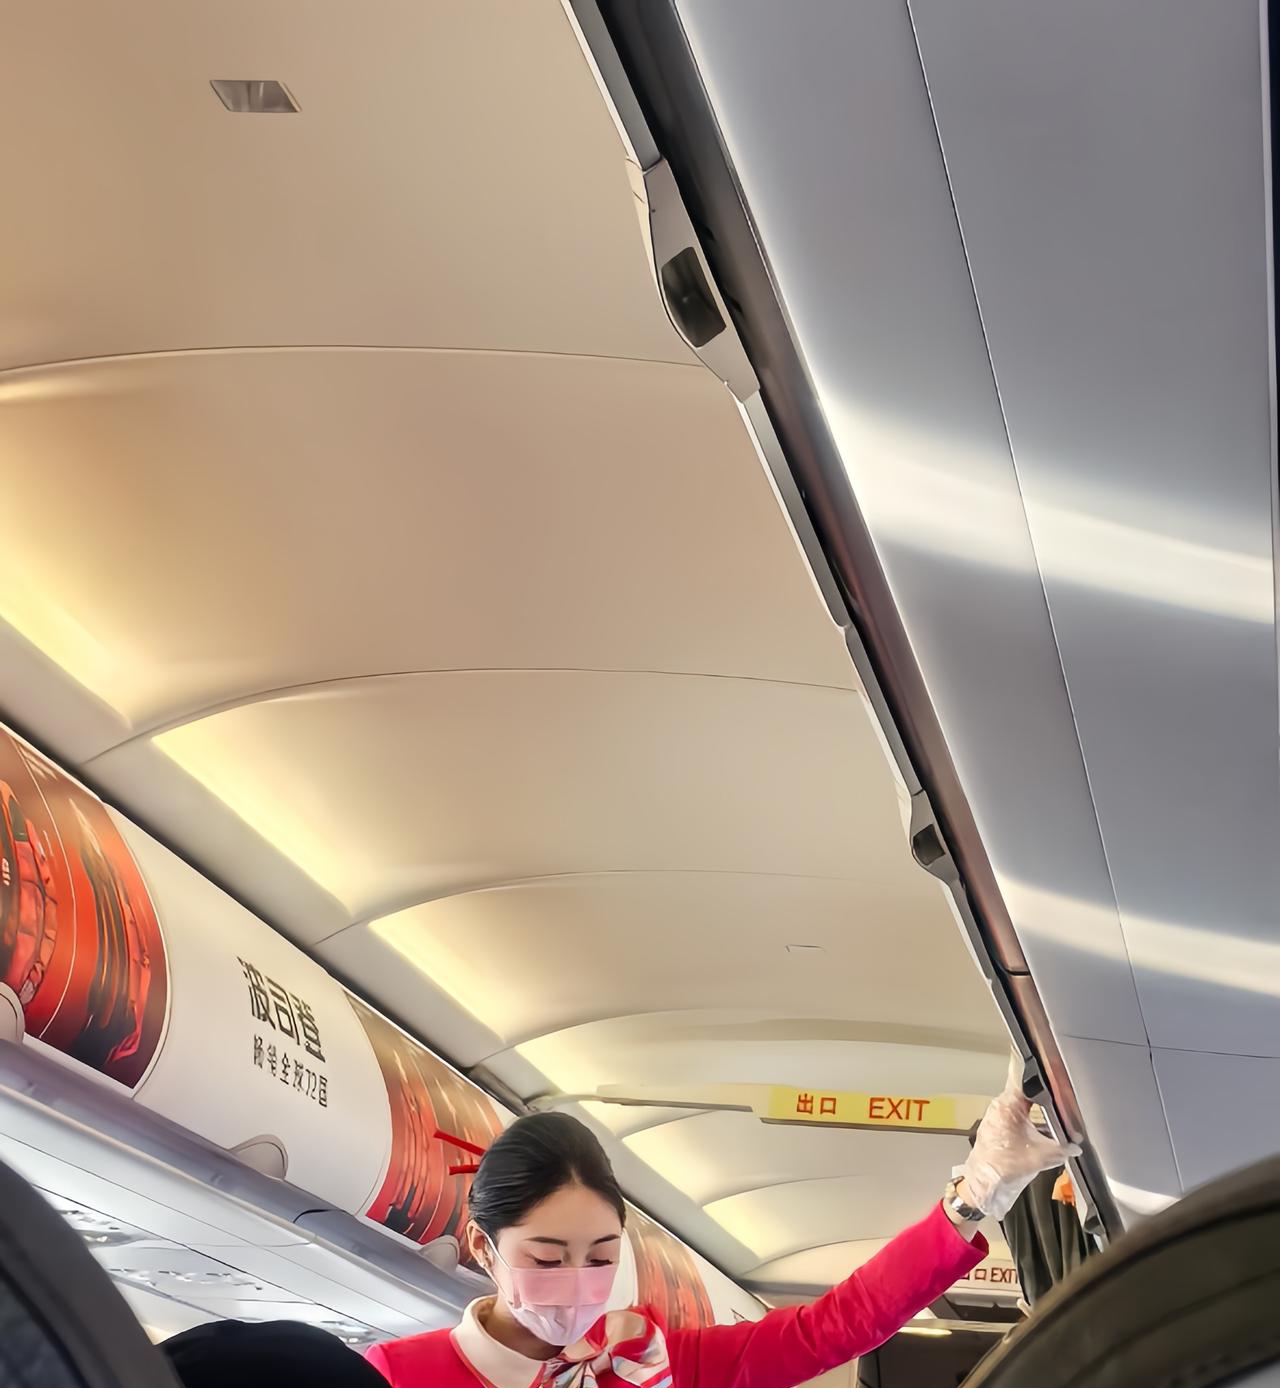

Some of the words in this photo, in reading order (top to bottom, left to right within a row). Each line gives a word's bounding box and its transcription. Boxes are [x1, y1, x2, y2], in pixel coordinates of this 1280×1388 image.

[236, 956, 326, 1063] 波司登
[796, 1093, 837, 1115] 出口
[869, 1097, 931, 1121] EXIT
